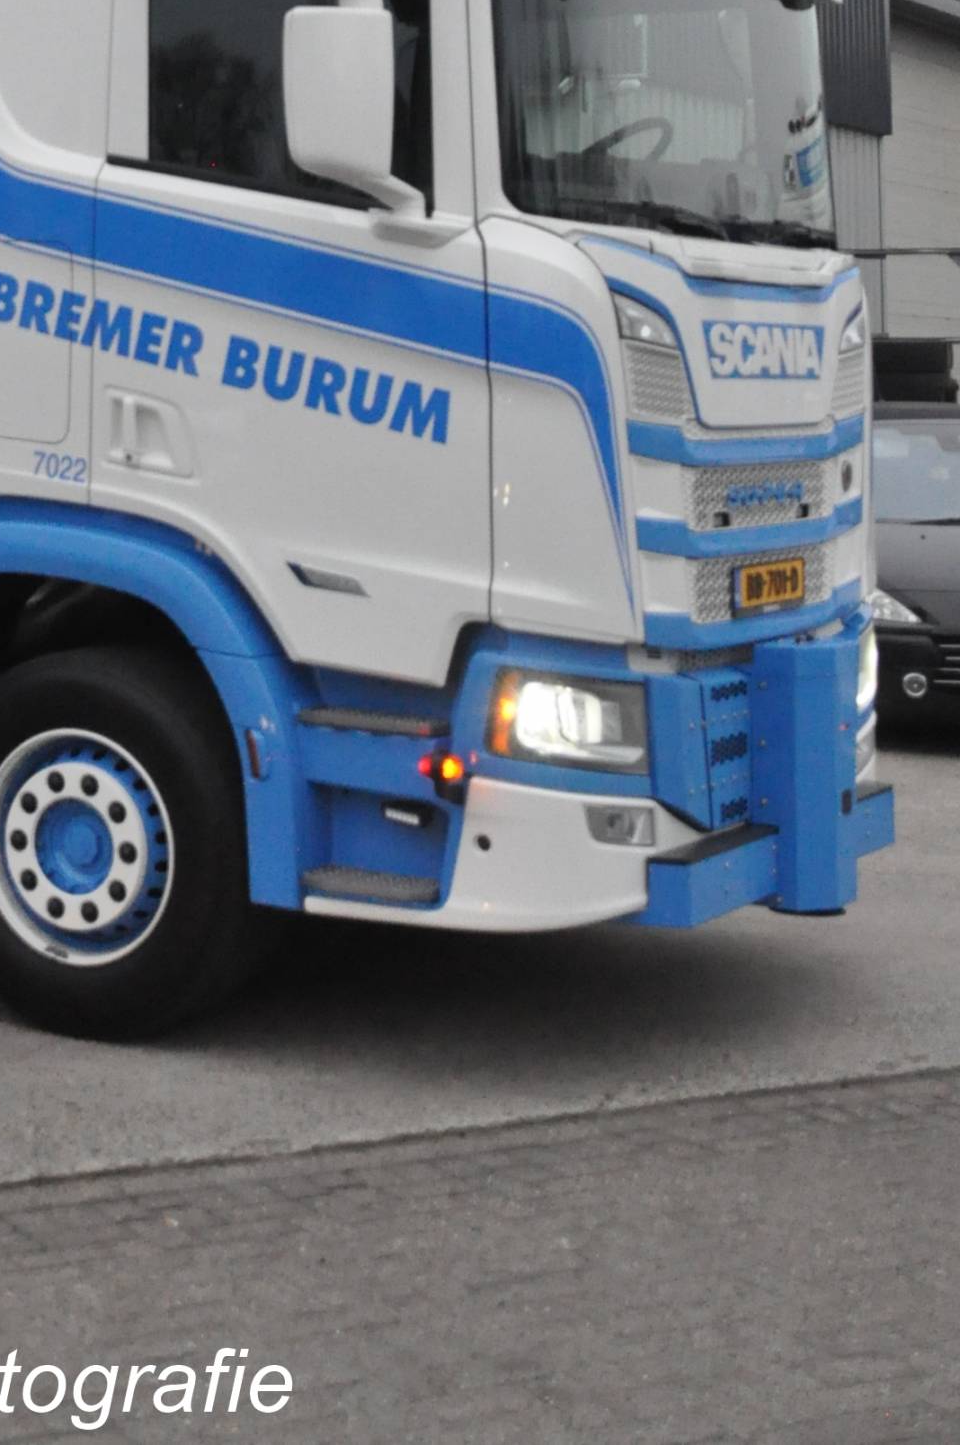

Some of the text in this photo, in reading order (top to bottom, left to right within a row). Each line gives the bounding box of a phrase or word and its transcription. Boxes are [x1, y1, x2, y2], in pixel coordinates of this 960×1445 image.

[709, 322, 820, 376] SCANIA
[222, 334, 451, 444] BURUM
[33, 450, 87, 483] 7022
